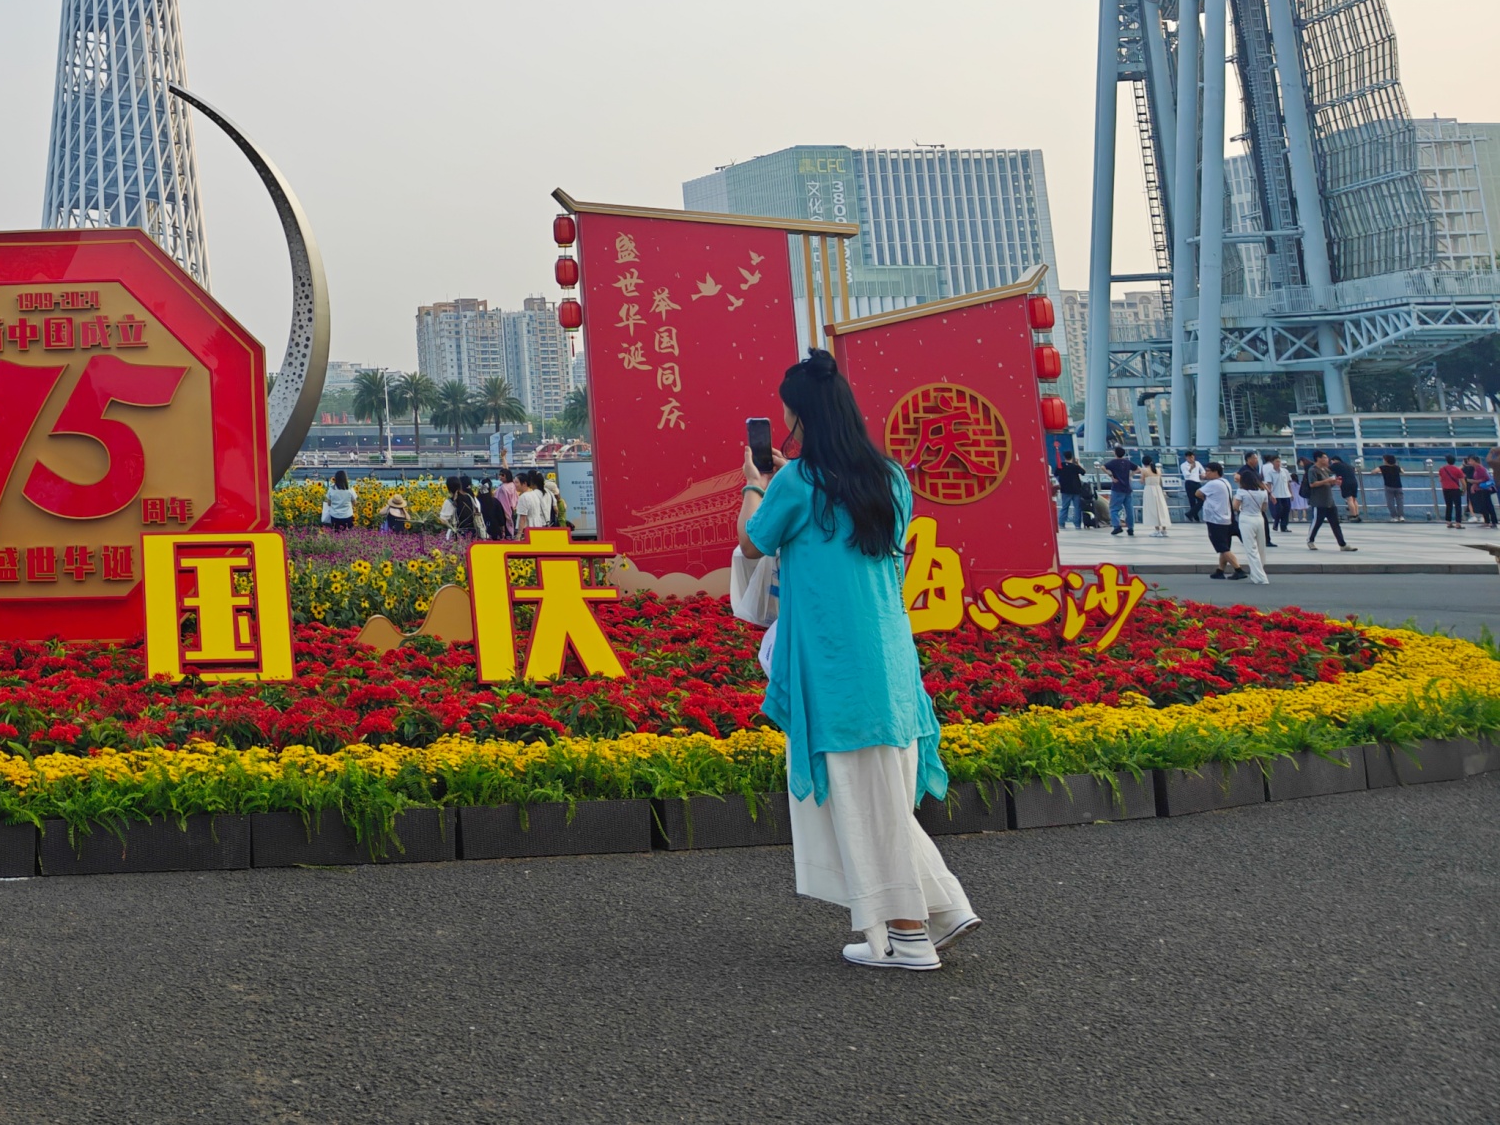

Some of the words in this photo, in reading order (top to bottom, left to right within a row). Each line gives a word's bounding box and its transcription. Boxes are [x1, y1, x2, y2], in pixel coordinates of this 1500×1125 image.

[16, 290, 101, 312] 1949-2024
[611, 231, 653, 371] 盛世华诞
[649, 286, 686, 431] 举国同庆
[141, 496, 194, 525] 周年
